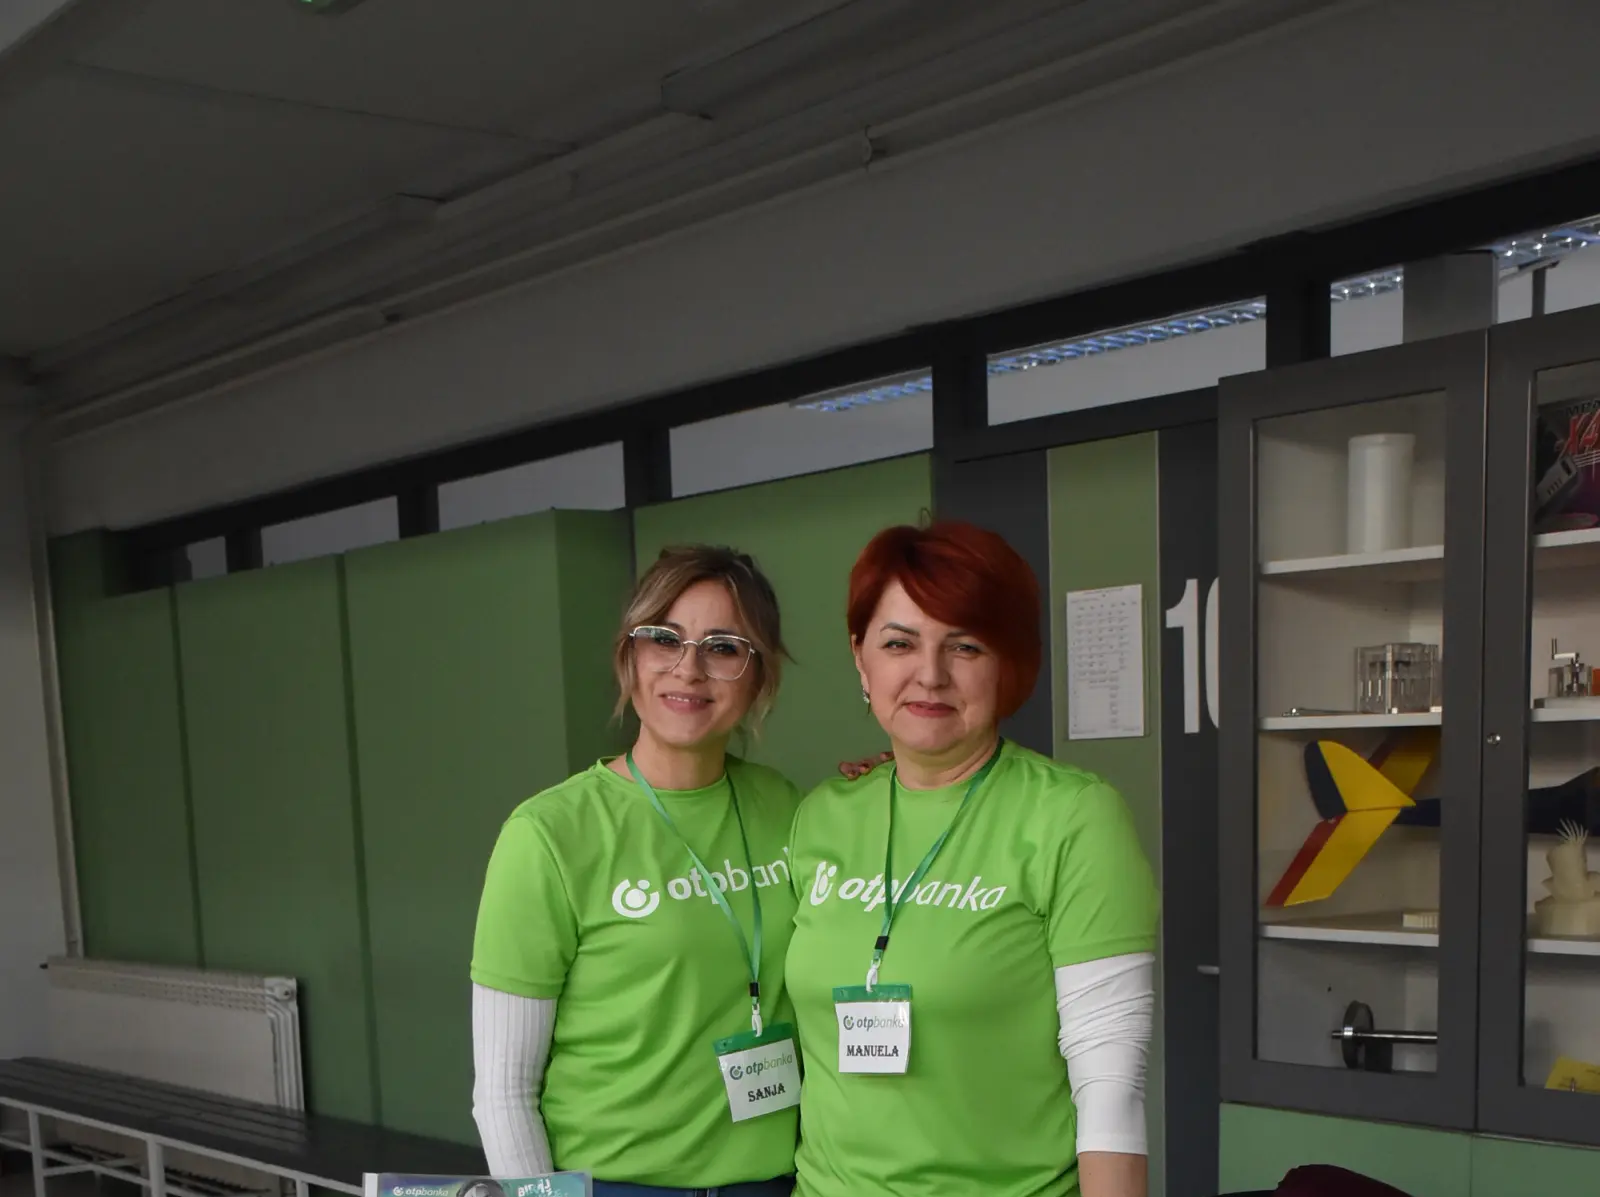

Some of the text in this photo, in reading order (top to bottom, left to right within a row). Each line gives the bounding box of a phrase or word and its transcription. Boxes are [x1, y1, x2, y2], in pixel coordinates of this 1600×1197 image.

[846, 1044, 899, 1057] MANUELA
[745, 1052, 793, 1076] otpbanka
[747, 1082, 786, 1103] SANJA
[405, 1185, 449, 1197] otpbanka
